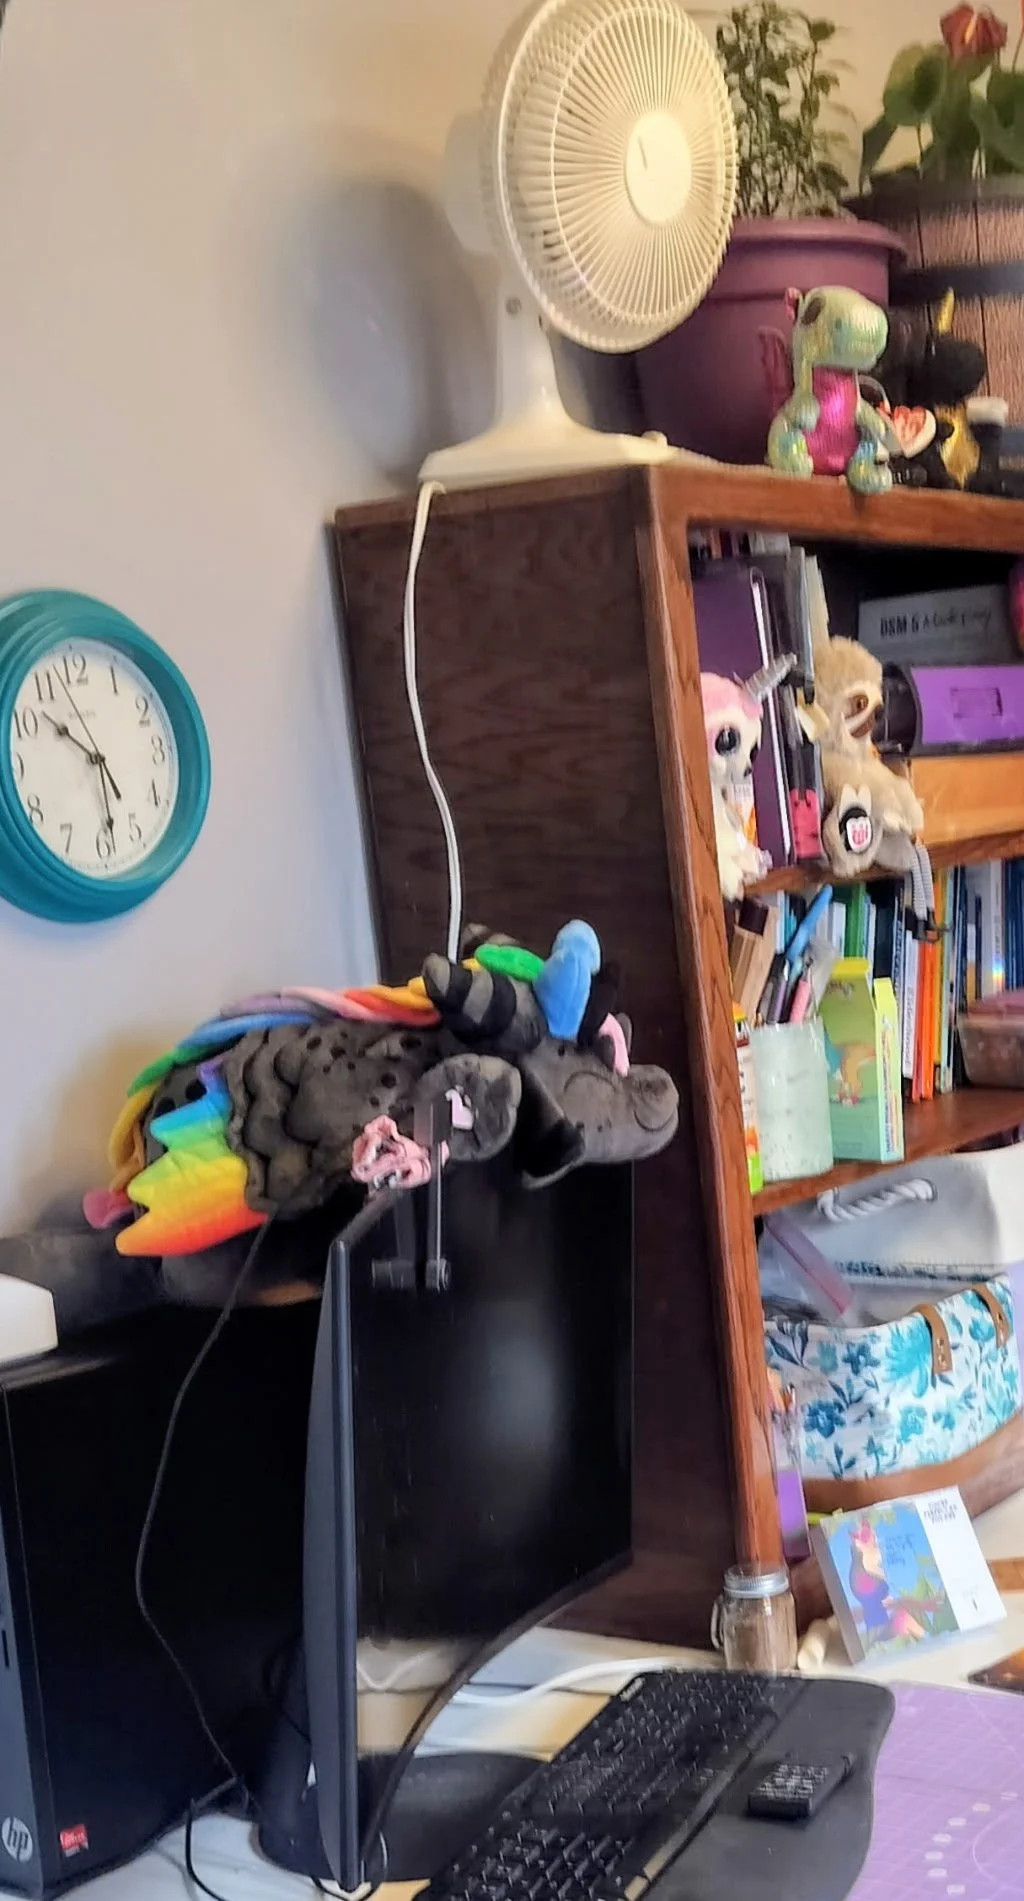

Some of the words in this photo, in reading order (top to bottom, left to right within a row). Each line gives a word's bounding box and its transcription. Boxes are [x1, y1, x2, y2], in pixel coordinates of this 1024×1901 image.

[62, 652, 89, 686] 12
[109, 664, 119, 697] 1
[34, 670, 54, 702] 11
[13, 706, 39, 740] 10
[135, 694, 151, 728] 2
[27, 792, 44, 825] 8
[147, 778, 161, 808] 4
[59, 822, 73, 854] 7
[95, 826, 112, 860] 6
[128, 812, 143, 844] 5
[4, 1817, 32, 1863] hp
